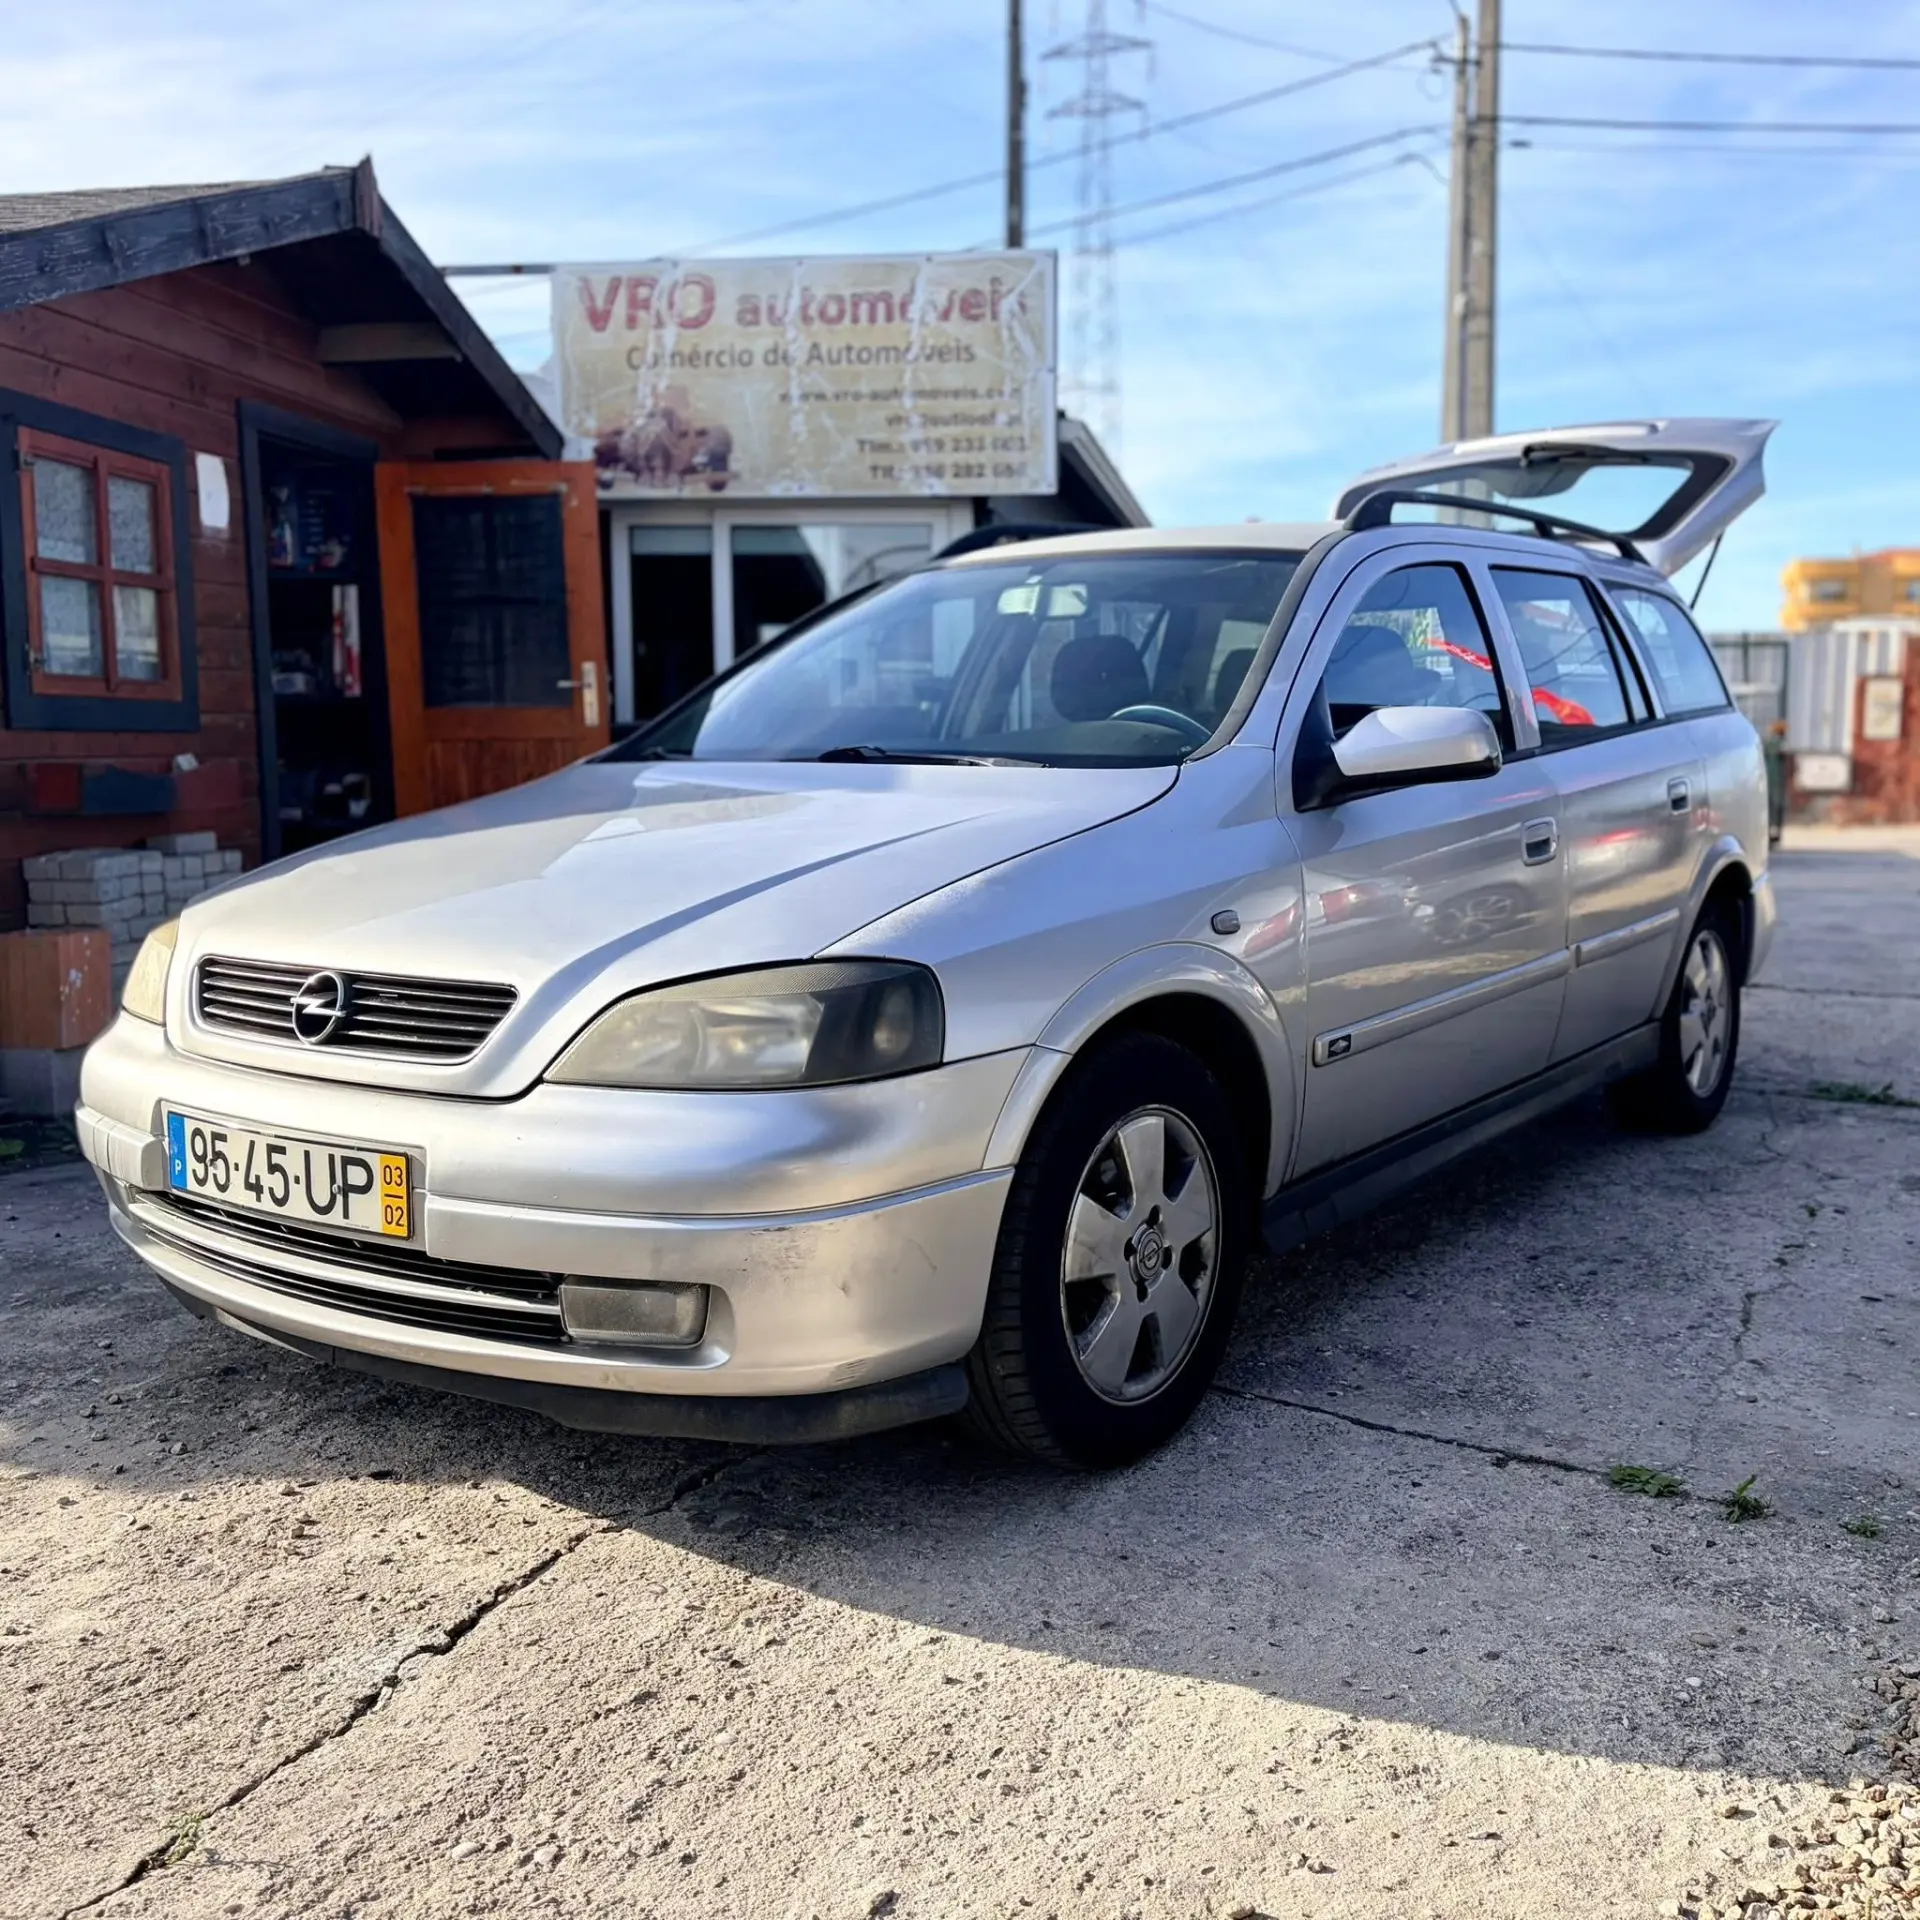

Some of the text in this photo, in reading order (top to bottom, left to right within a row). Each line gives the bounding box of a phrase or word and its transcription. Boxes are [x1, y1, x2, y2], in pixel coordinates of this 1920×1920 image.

[578, 273, 716, 333] VRO
[174, 1158, 182, 1175] P
[383, 1164, 404, 1188] 03
[384, 1204, 405, 1227] 02
